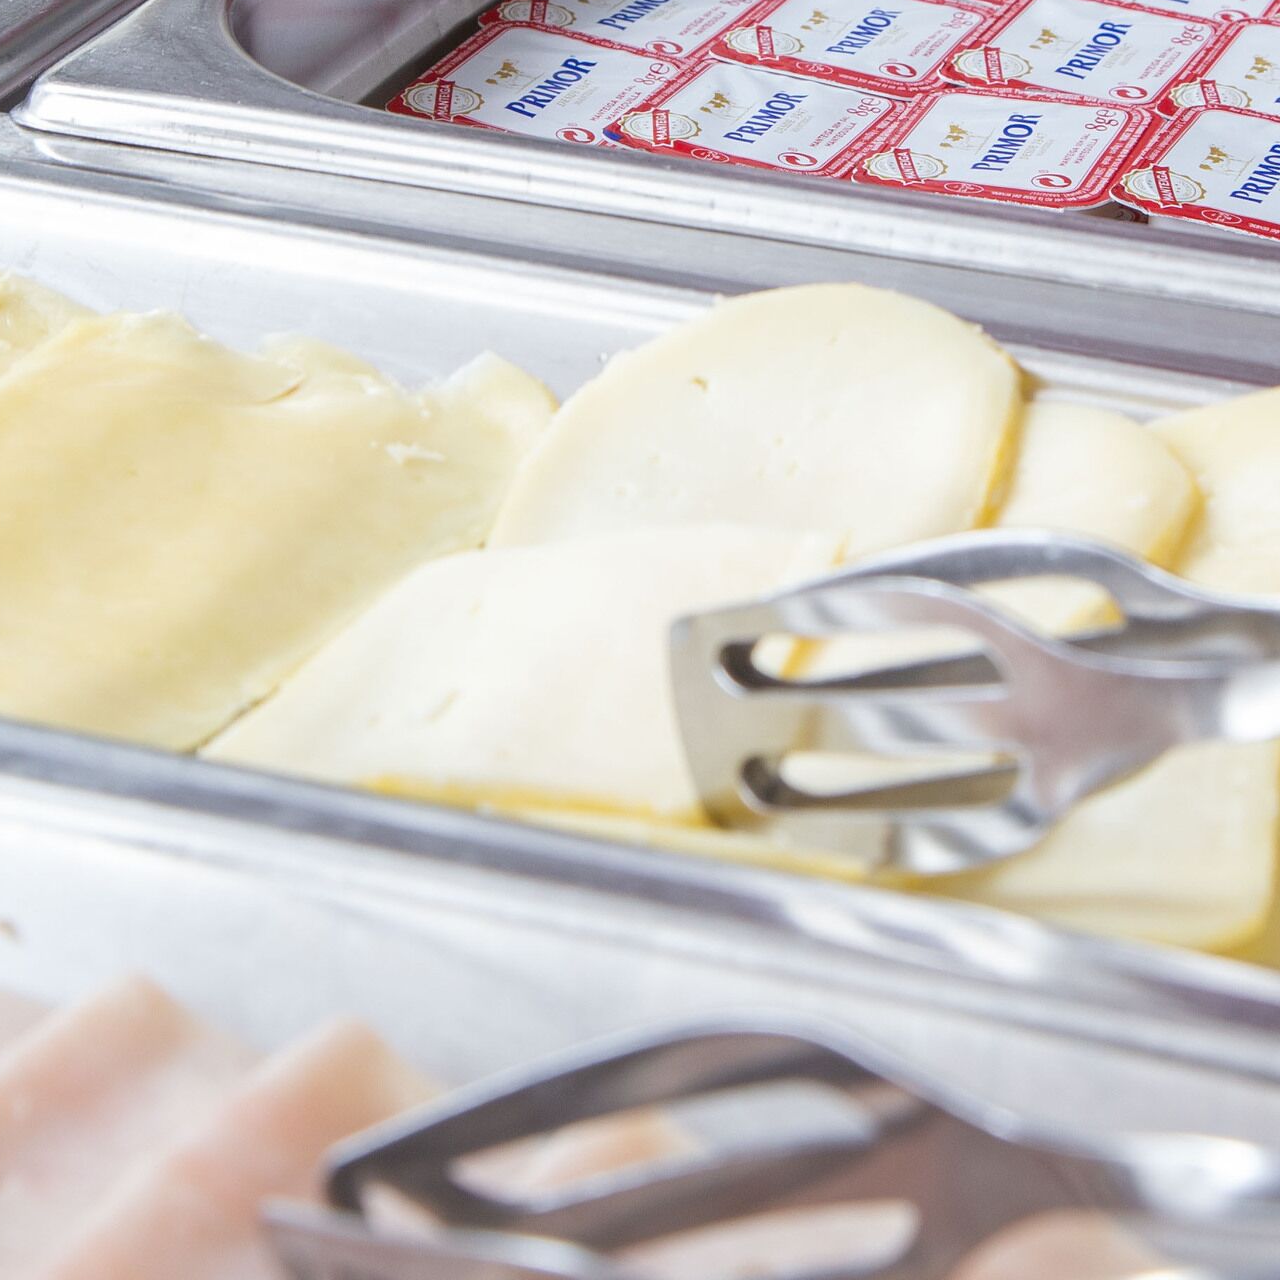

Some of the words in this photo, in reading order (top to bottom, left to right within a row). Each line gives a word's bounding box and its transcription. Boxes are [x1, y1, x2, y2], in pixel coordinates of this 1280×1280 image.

[758, 29, 775, 57] MANTEIGA
[825, 7, 902, 56] PRIMOR
[986, 50, 1003, 81] MANTEIGA
[1055, 21, 1132, 80] PRIMOR
[437, 83, 451, 119] MANTEIGA
[505, 56, 598, 118] PRIMOR
[656, 113, 667, 141] MANTEIGA
[723, 91, 808, 143] PRIMOR
[971, 112, 1044, 171] PRIMOR
[897, 152, 918, 180] MANTEIGA
[1154, 170, 1179, 203] MANTEIGA
